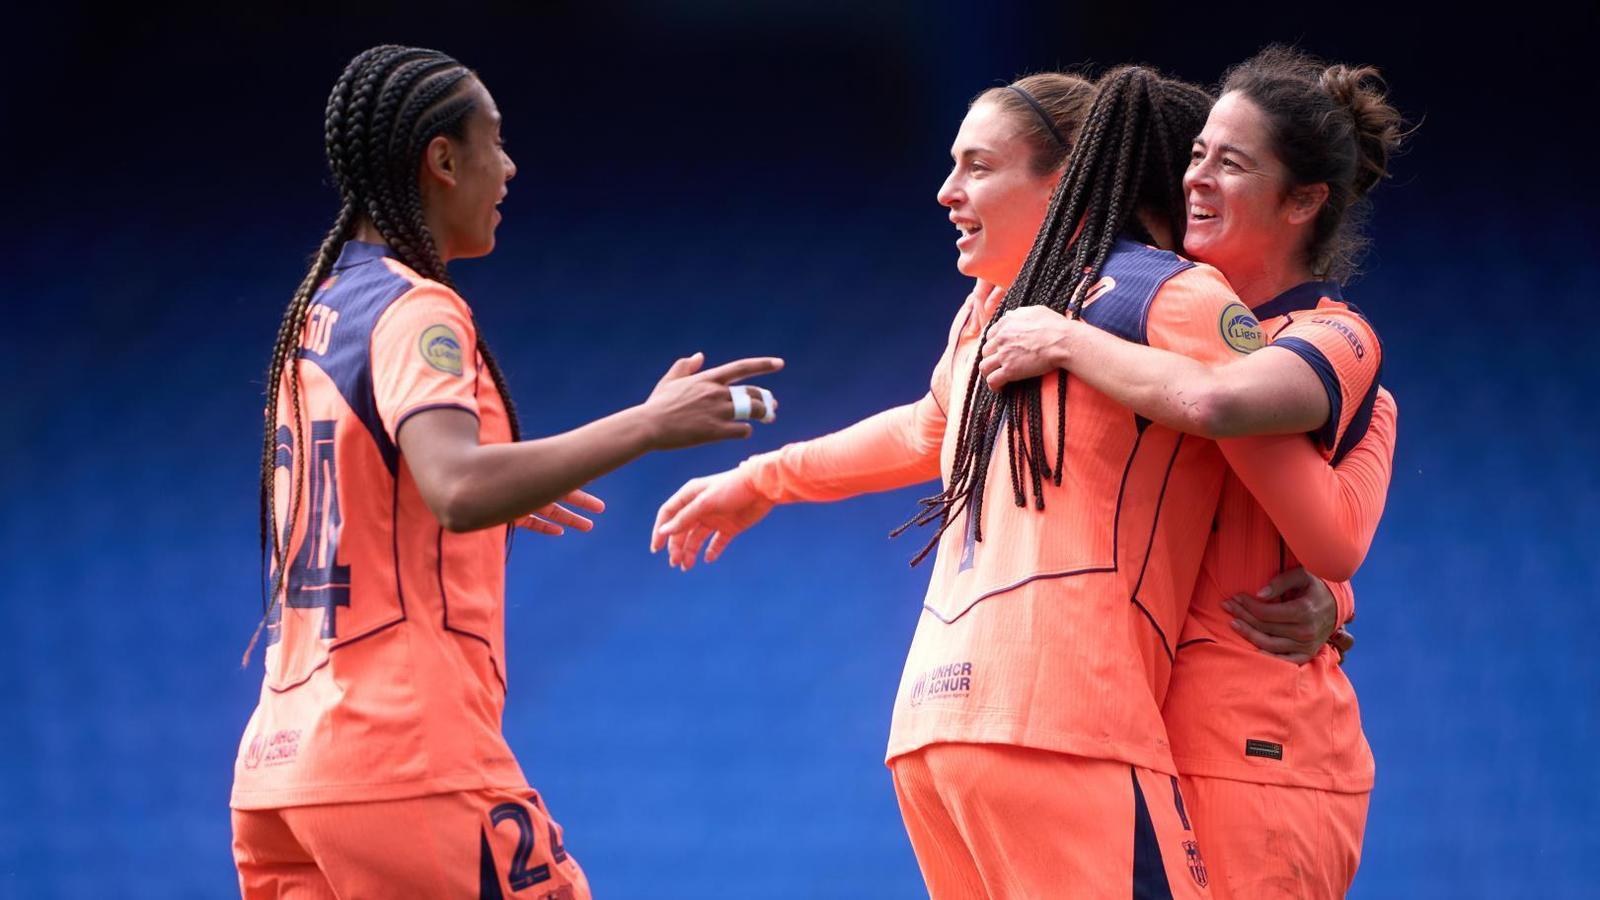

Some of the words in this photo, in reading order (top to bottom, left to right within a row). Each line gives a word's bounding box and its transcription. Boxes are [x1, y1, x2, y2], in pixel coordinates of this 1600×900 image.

[264, 420, 351, 639] 24
[931, 662, 972, 681] UNHCR
[928, 677, 970, 695] ACNUR
